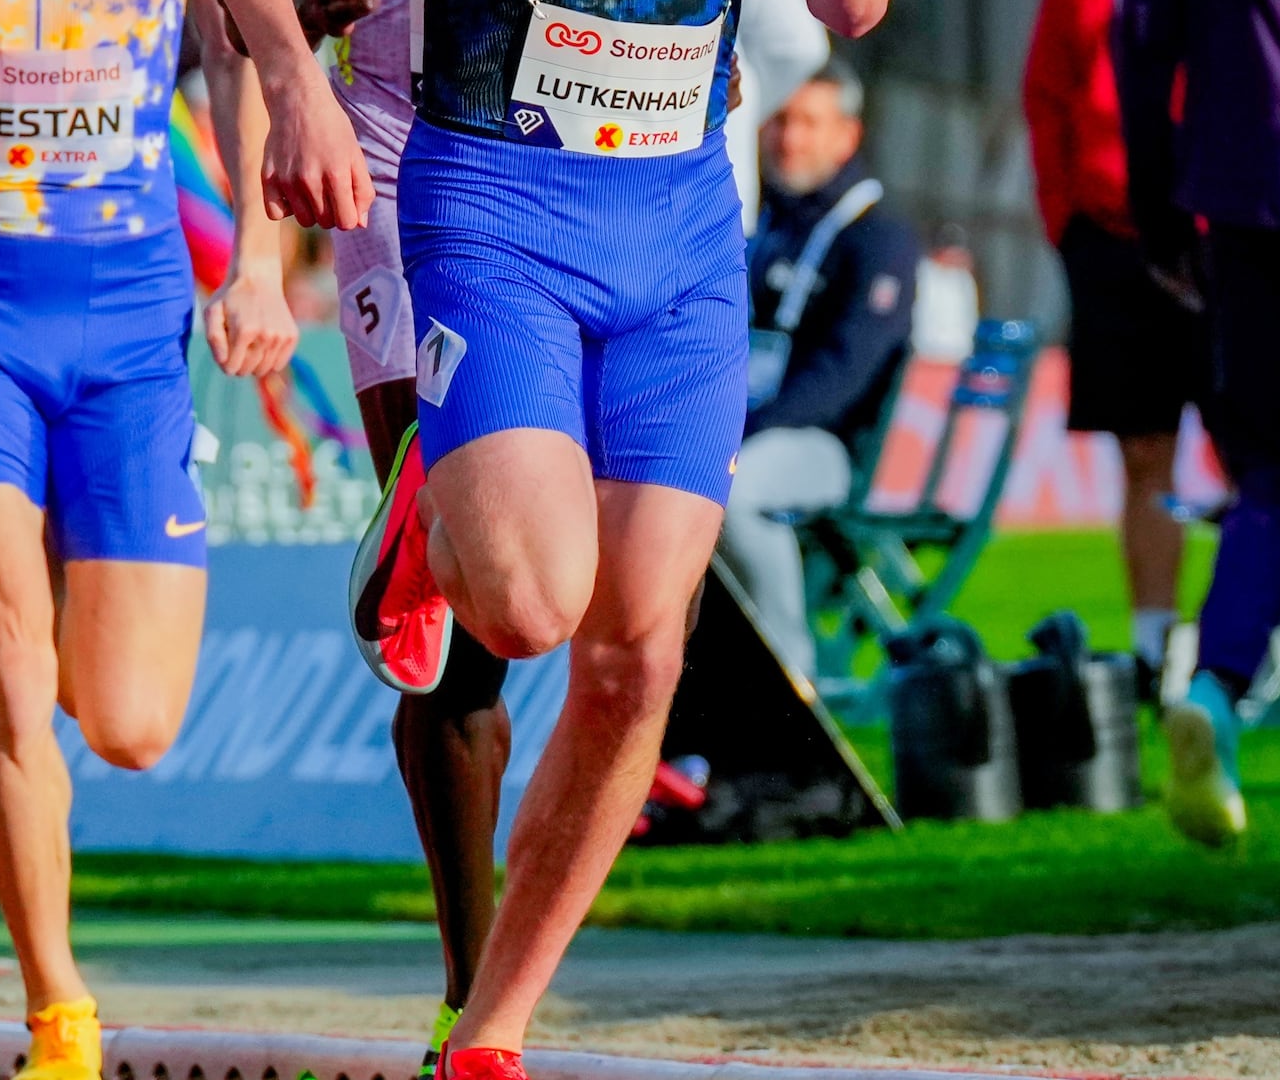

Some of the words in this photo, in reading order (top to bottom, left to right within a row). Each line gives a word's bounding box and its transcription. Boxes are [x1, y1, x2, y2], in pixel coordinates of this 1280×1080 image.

[609, 35, 717, 62] Storebrand
[3, 63, 120, 85] Storebrand
[536, 74, 702, 111] LUTKENHAUS
[628, 130, 678, 146] EXTRA
[41, 150, 97, 163] EXTRA
[355, 285, 380, 335] 5
